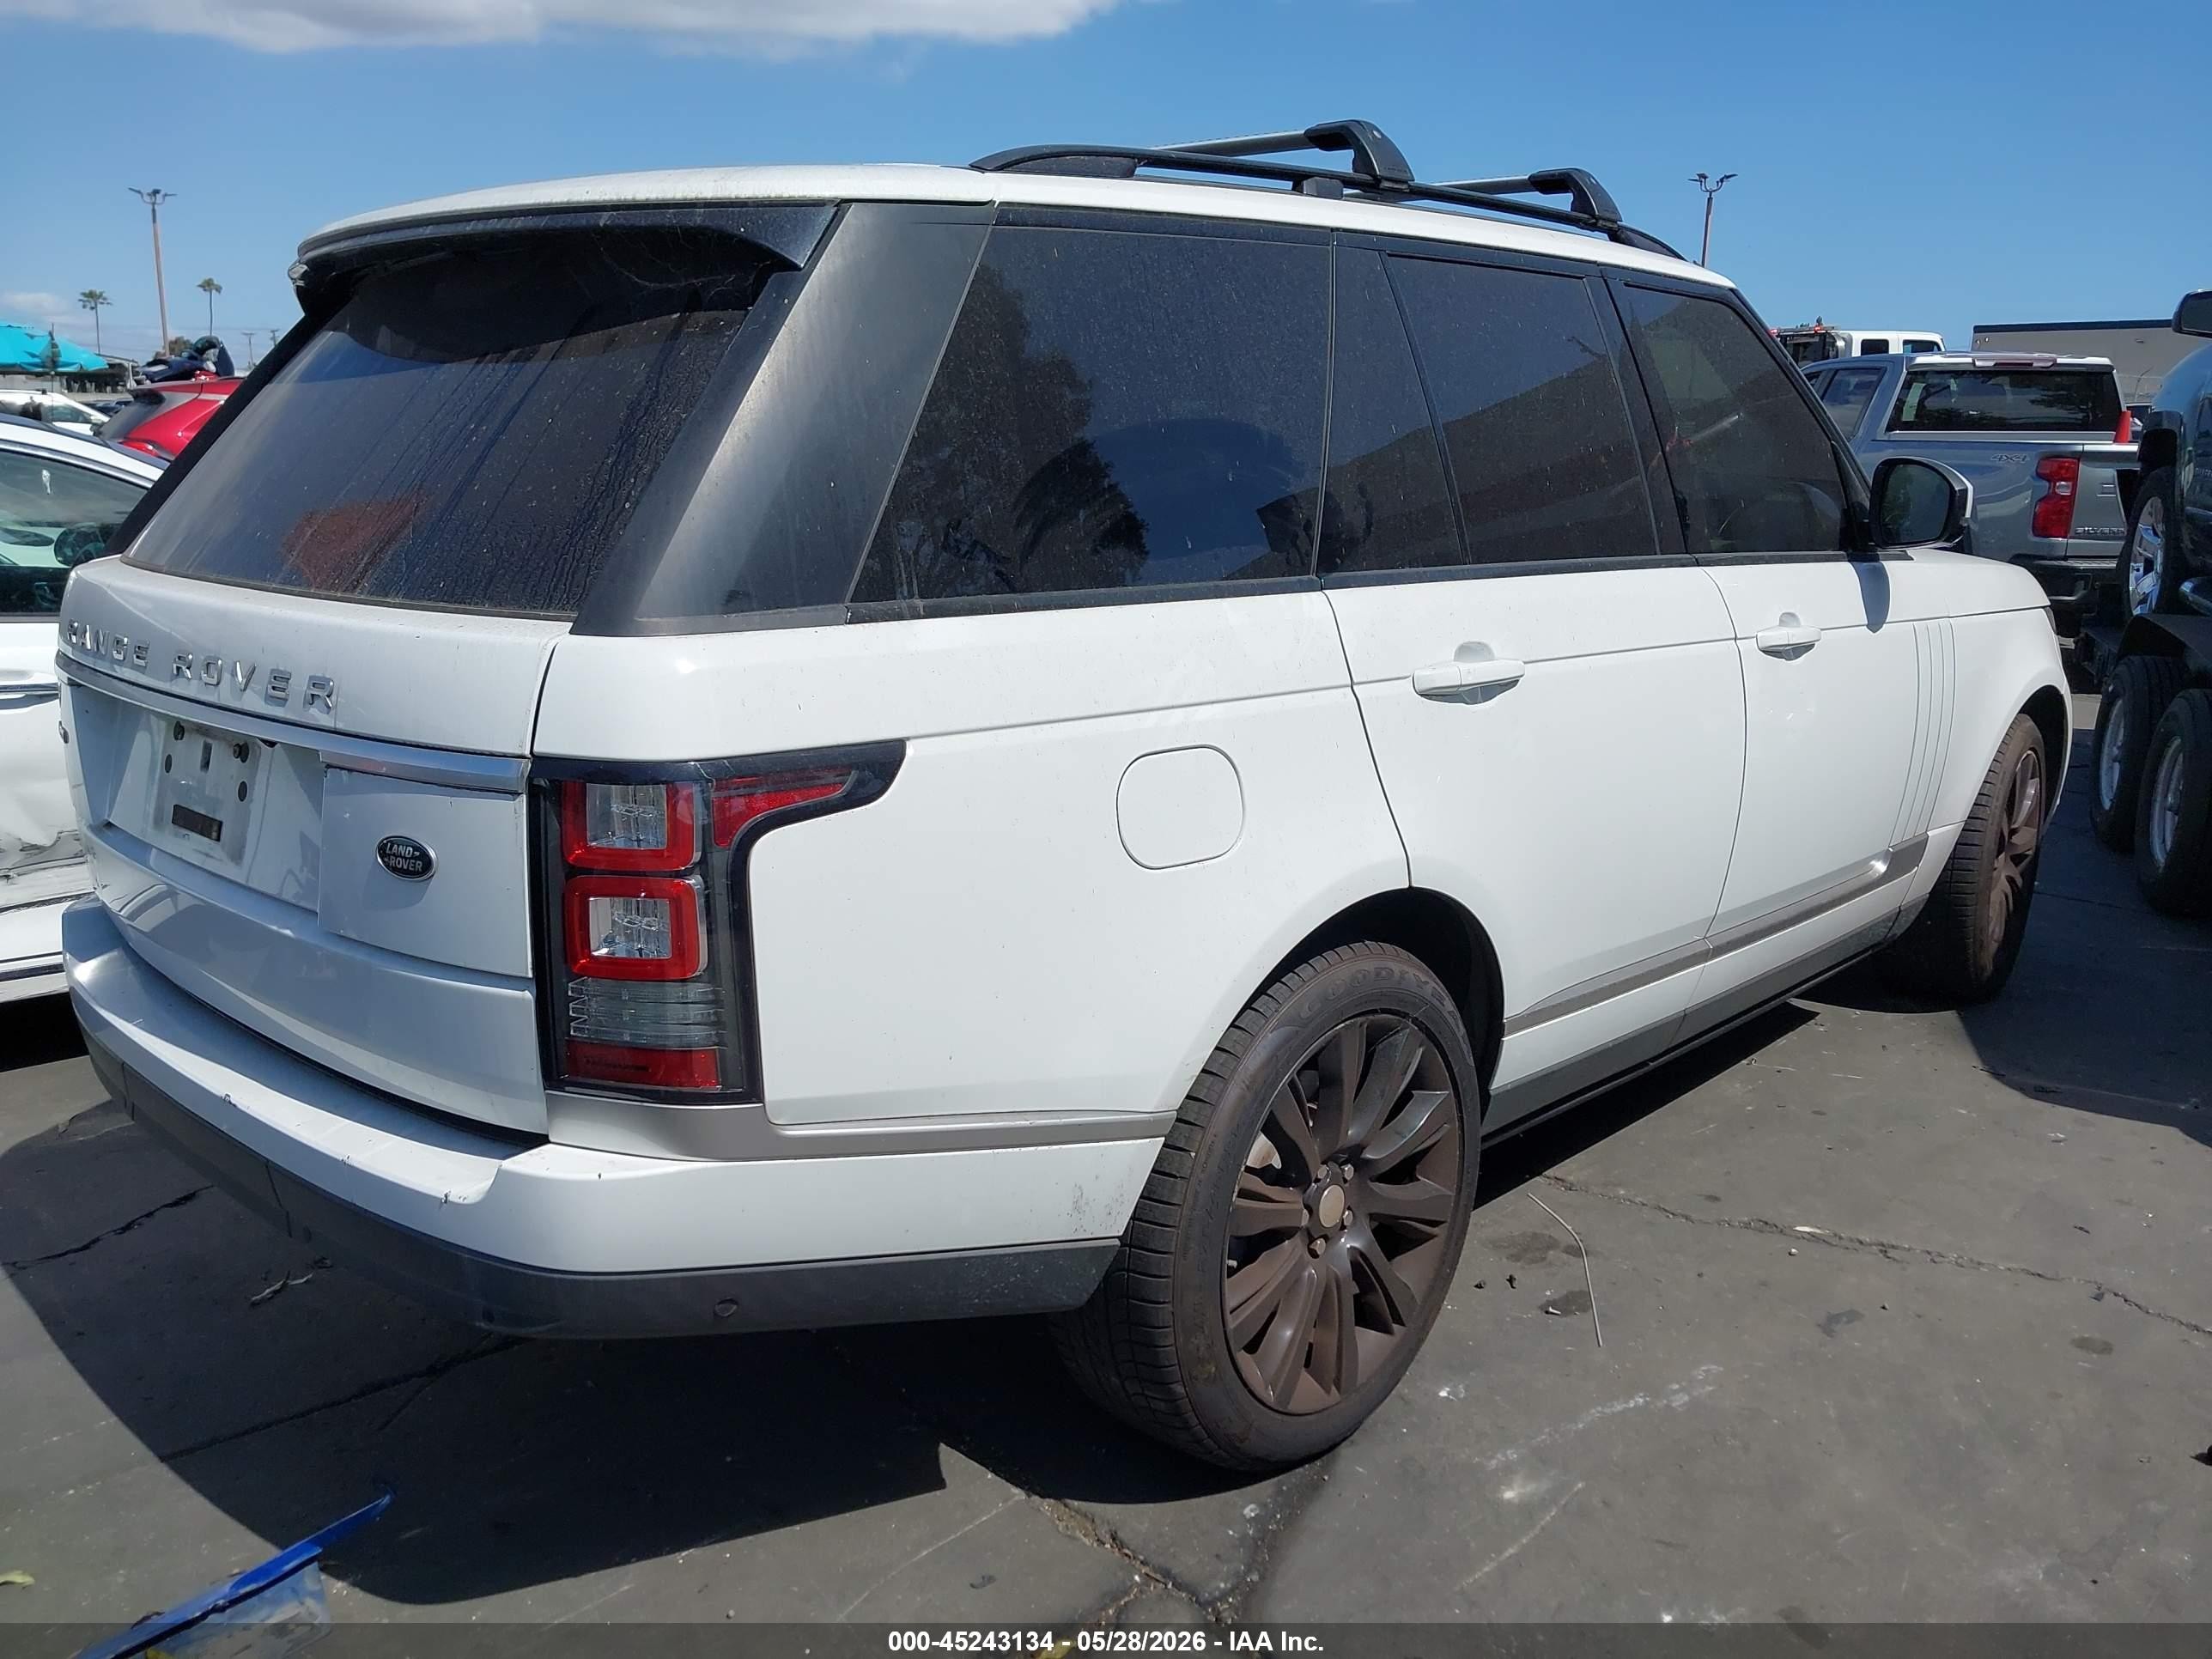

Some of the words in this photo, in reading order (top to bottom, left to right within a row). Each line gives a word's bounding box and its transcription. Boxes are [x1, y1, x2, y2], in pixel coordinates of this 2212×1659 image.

[68, 619, 149, 667] RANGE
[173, 653, 334, 710] ROVER
[386, 842, 414, 858] LAND
[389, 855, 423, 872] ROVER
